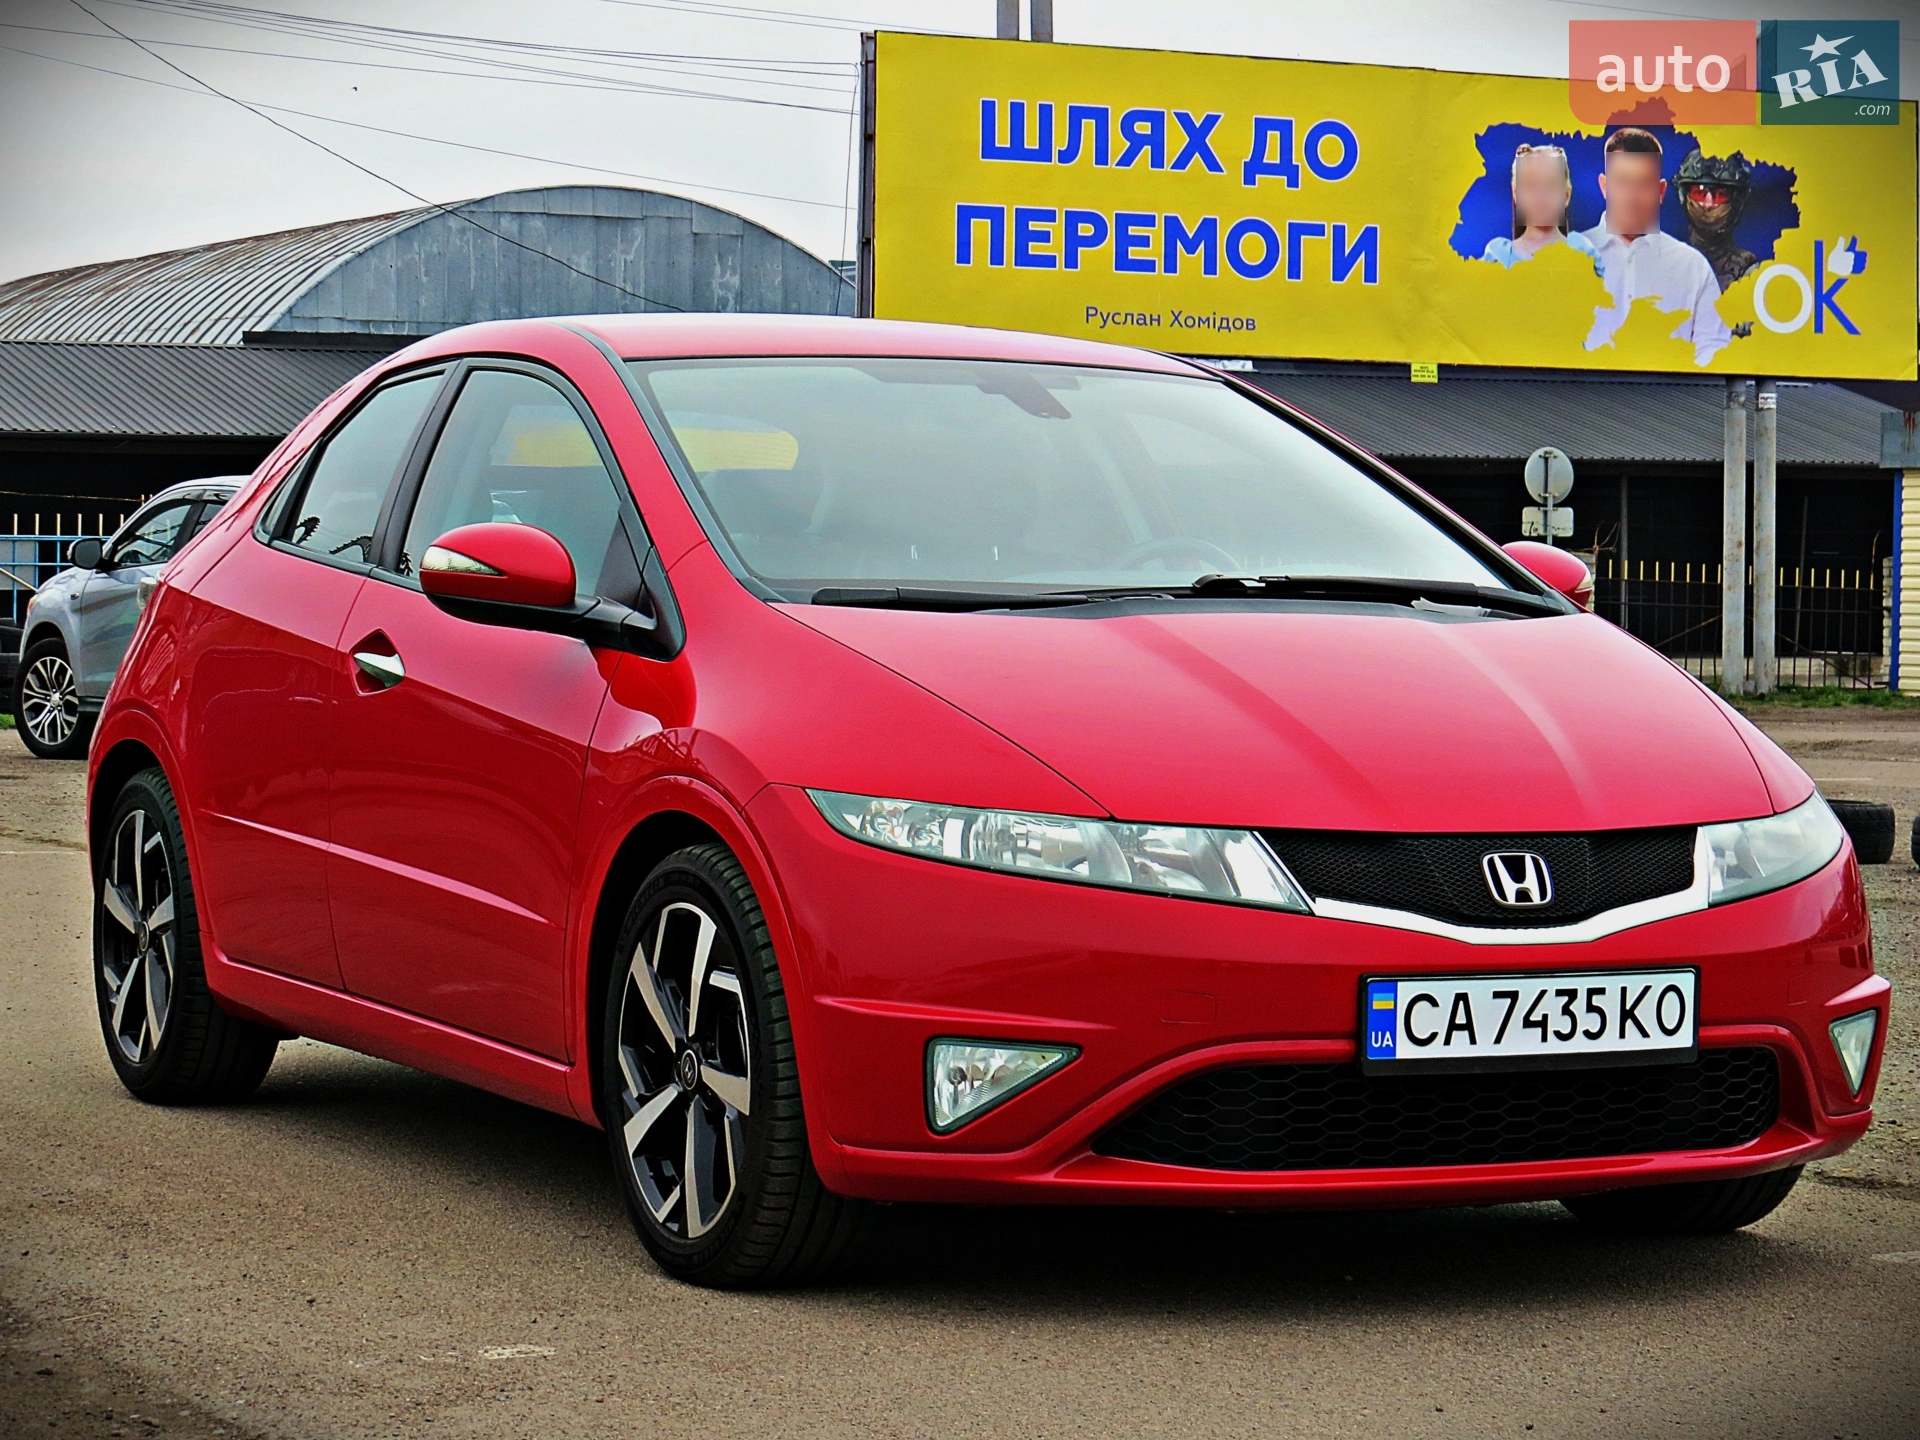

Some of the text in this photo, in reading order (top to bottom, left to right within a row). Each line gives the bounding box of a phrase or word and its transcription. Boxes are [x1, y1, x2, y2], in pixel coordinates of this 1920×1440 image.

[980, 98, 1359, 190] ШЛЯХ ДО
[955, 203, 1380, 285] ПЕРЕМОГИ
[1085, 305, 1256, 334] Руслан Хомідов
[1371, 1031, 1394, 1048] UA
[1403, 984, 1687, 1047] CA 7435 KO
